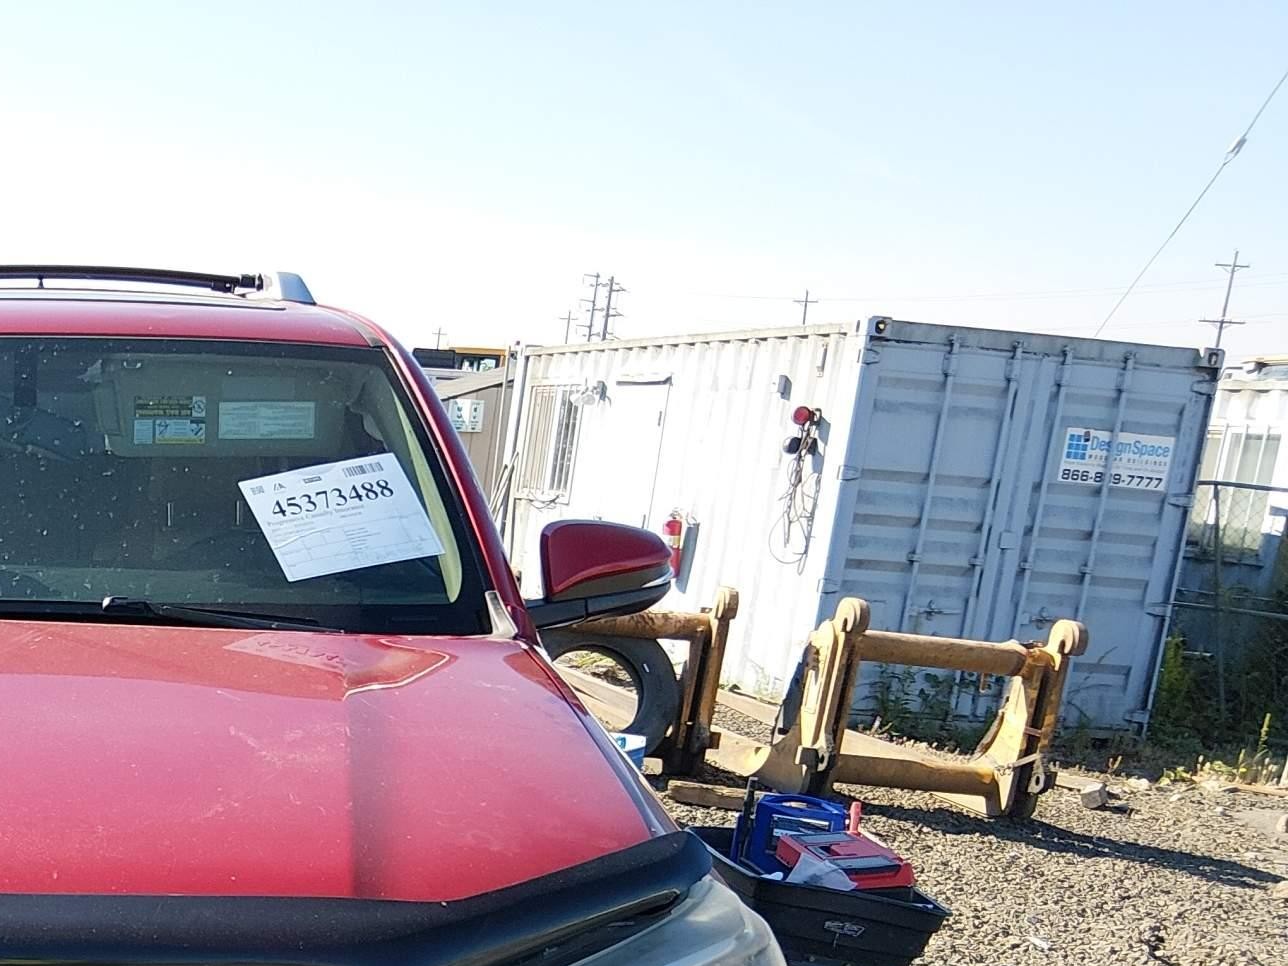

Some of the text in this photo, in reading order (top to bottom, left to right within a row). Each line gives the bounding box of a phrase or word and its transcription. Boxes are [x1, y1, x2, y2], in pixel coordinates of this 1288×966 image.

[1090, 435, 1170, 458] DesgnSpace
[1061, 468, 1163, 489] 866-89-7777
[272, 479, 394, 517] 45373488
